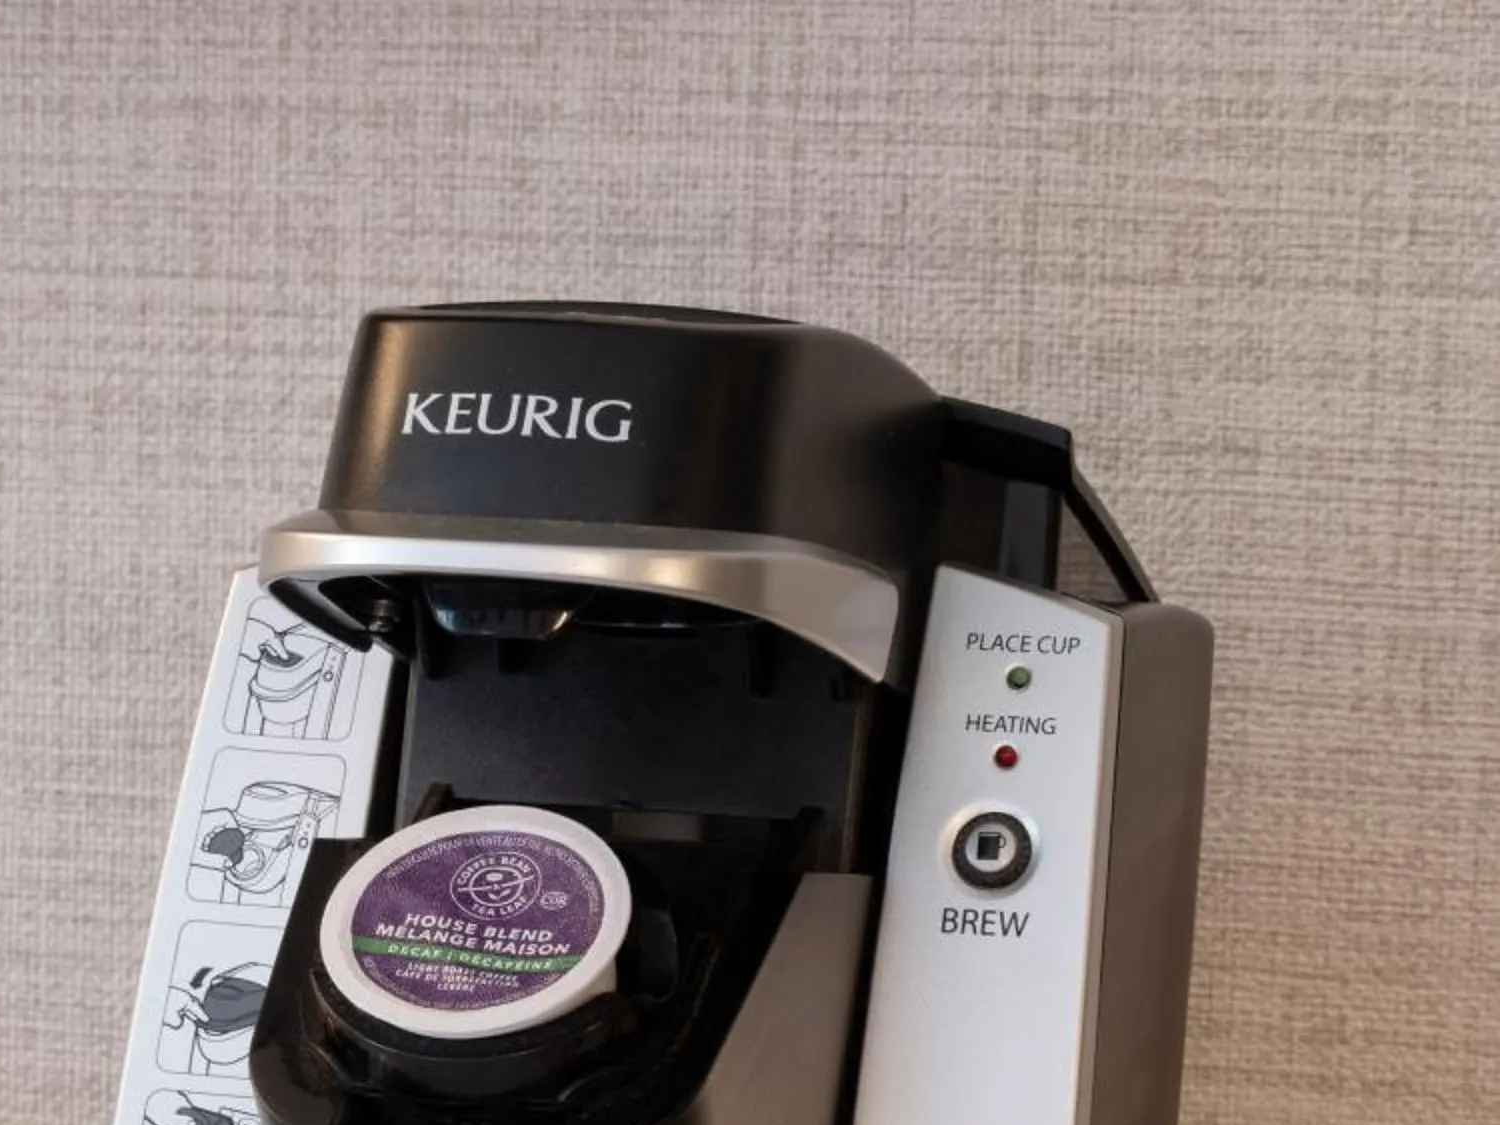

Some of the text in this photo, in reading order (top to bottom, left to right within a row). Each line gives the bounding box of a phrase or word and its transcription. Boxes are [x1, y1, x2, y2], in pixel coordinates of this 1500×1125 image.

[402, 392, 632, 442] KEURIG
[965, 632, 1081, 655] PLACE CUP
[964, 713, 1057, 735] HEATING
[470, 902, 495, 916] TEA
[404, 912, 554, 943] HOUSE BLEND
[940, 907, 1030, 938] BREW
[483, 939, 571, 957] MAISON
